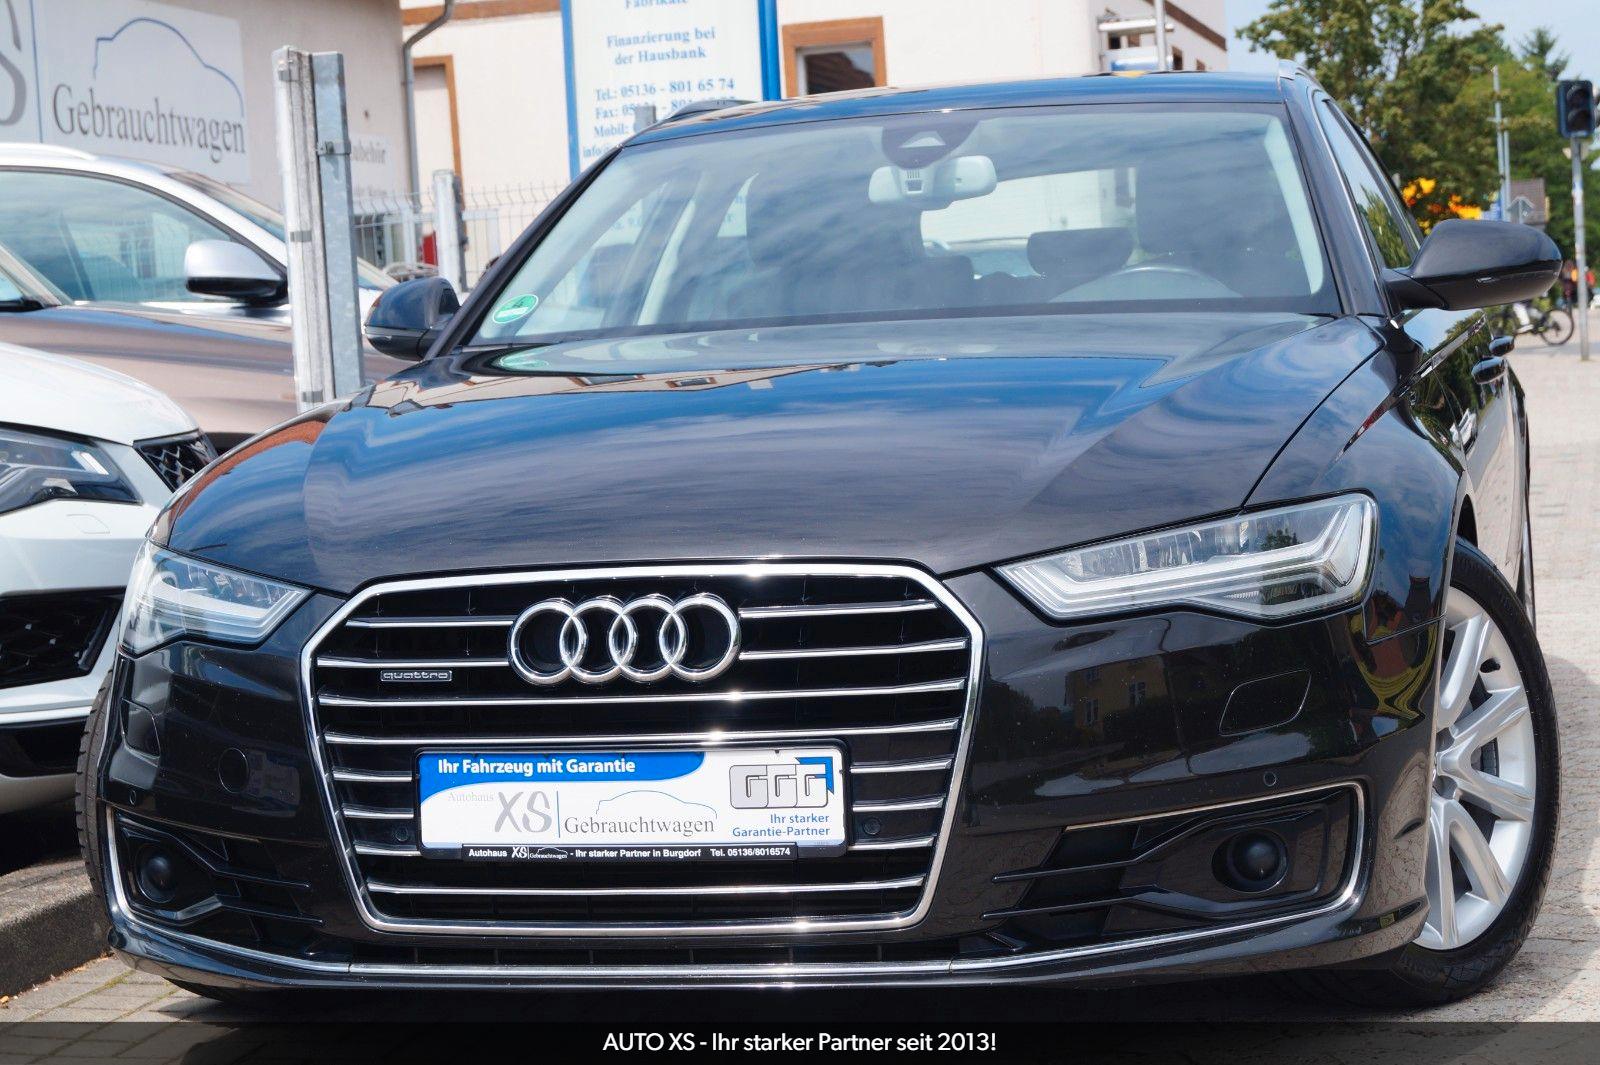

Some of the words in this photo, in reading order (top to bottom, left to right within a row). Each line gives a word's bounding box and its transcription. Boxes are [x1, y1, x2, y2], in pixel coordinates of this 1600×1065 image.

[606, 31, 690, 48] Finanzierung
[695, 27, 716, 40] bei
[614, 52, 633, 65] der
[638, 47, 707, 62] Hausbank
[621, 84, 656, 97] 05136
[669, 81, 691, 93] 801
[698, 79, 713, 91] 65
[719, 78, 735, 90] 74
[595, 107, 618, 119] Fax:
[53, 83, 246, 163] Gebrauchtwagen
[383, 671, 449, 680] quattro
[438, 759, 459, 773] Ihr
[462, 759, 533, 776] Fahrzeug
[537, 758, 563, 773] mit
[566, 758, 636, 773] Garantie
[448, 791, 494, 802] Autohaus
[494, 790, 552, 833] XS
[770, 813, 786, 824] Ihr
[789, 813, 830, 823] starker
[564, 816, 715, 837] Gebrauchtwagen
[732, 826, 831, 837] Garantie-Partner
[468, 848, 508, 857] Autohaus
[511, 846, 528, 858] XS
[529, 852, 568, 860] Gebrauchtwagen
[575, 849, 586, 857] Ihr
[588, 849, 618, 857] starker
[620, 849, 651, 857] Partner
[652, 849, 661, 857] in
[663, 848, 702, 859] Burgdorf
[710, 848, 725, 857] Tel.
[727, 847, 791, 857] 05136/8016574
